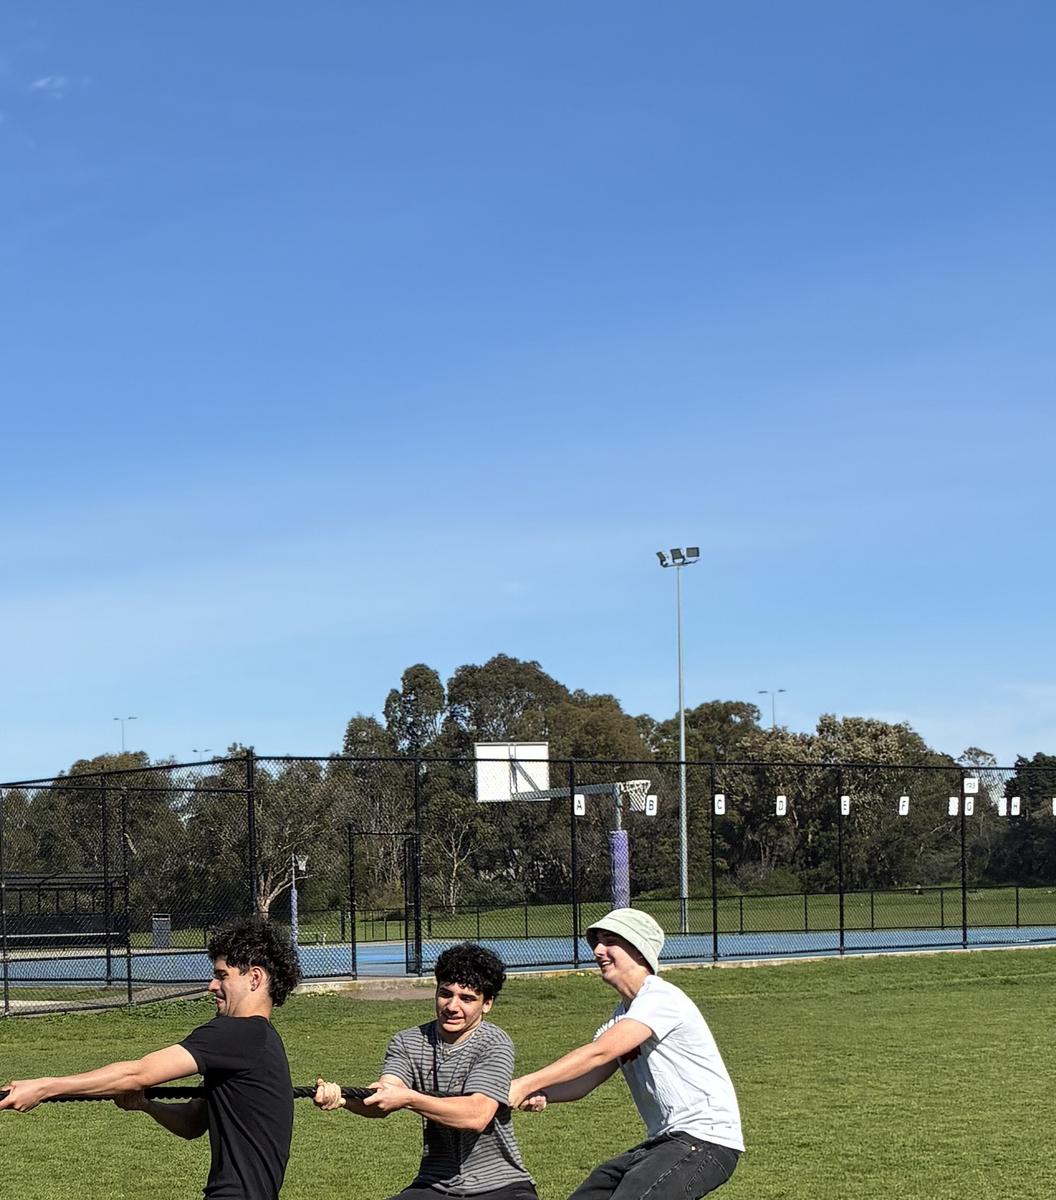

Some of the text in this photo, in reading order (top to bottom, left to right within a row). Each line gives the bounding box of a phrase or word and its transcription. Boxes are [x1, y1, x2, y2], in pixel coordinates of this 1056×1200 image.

[576, 799, 583, 811] A
[648, 799, 655, 811] B
[717, 799, 723, 810] C
[778, 800, 784, 811] D
[843, 800, 848, 811] E
[901, 800, 906, 811] F
[966, 801, 972, 811] G
